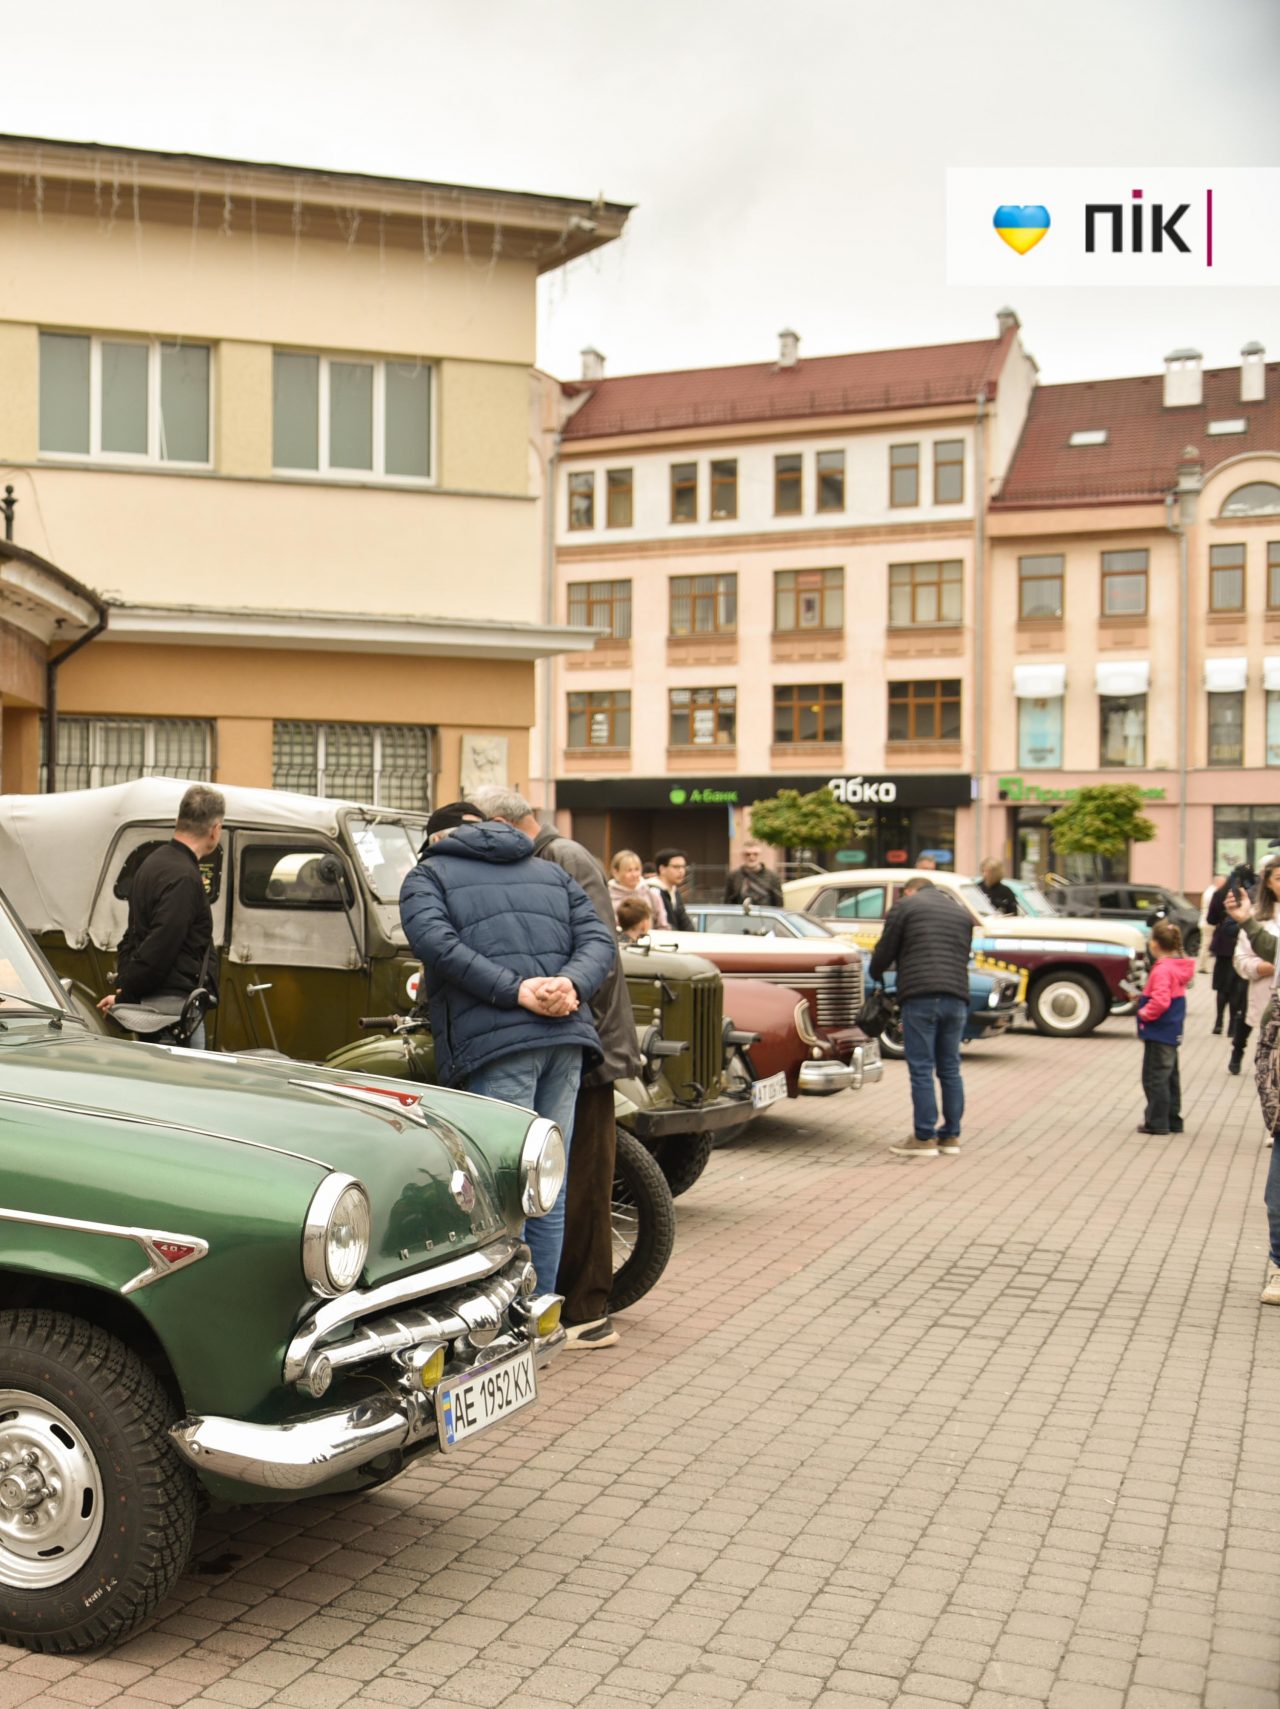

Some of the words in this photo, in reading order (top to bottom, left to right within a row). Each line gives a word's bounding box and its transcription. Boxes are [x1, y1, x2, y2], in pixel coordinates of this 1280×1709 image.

[828, 776, 897, 803] Ябко
[454, 1386, 477, 1433] AE
[480, 1370, 512, 1417] 1952
[513, 1358, 532, 1402] KX
